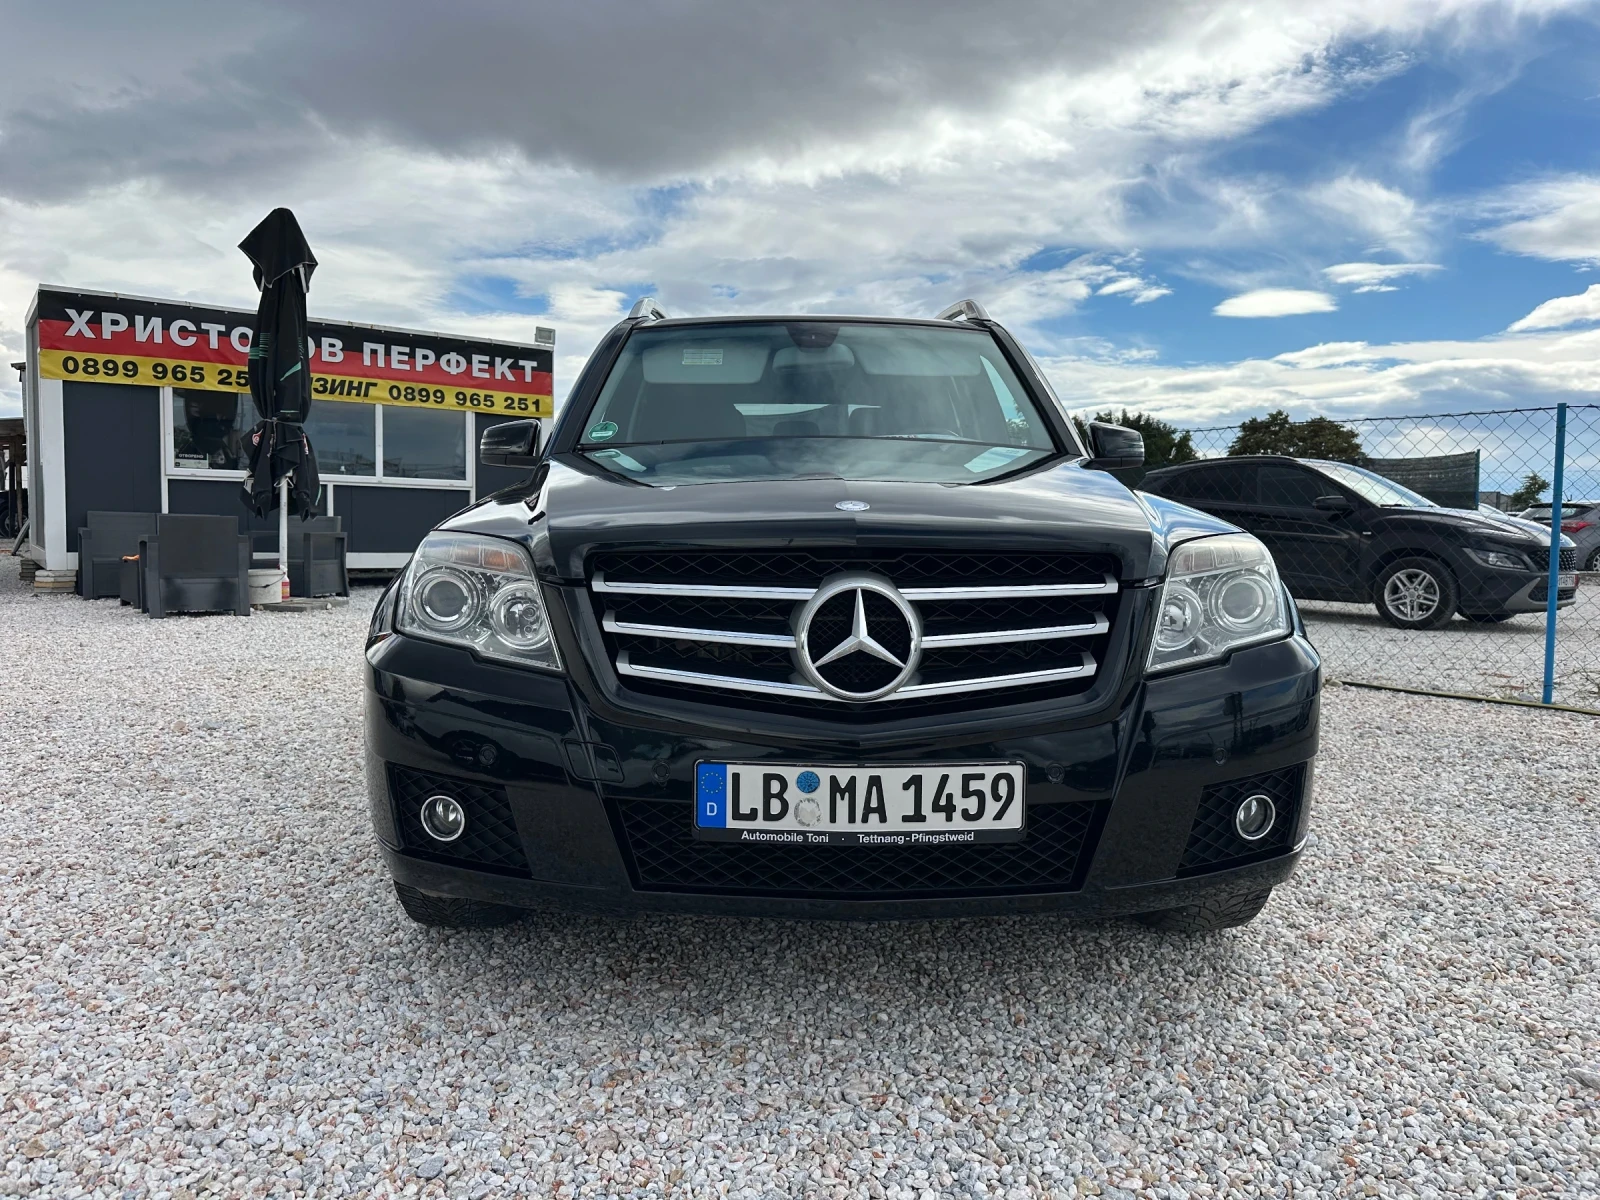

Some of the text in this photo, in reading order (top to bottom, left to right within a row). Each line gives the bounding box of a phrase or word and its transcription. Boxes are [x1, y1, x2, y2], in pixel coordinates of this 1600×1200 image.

[64, 308, 538, 383] ХРИСТОВ ПЕРФЕКТ
[62, 356, 541, 412] 0899 965 25 ЗИНГ 0899 965 251
[706, 772, 1016, 824] D LB MA 1459
[741, 830, 974, 845] Automobile Toni Tettnang-Pfingstweid
